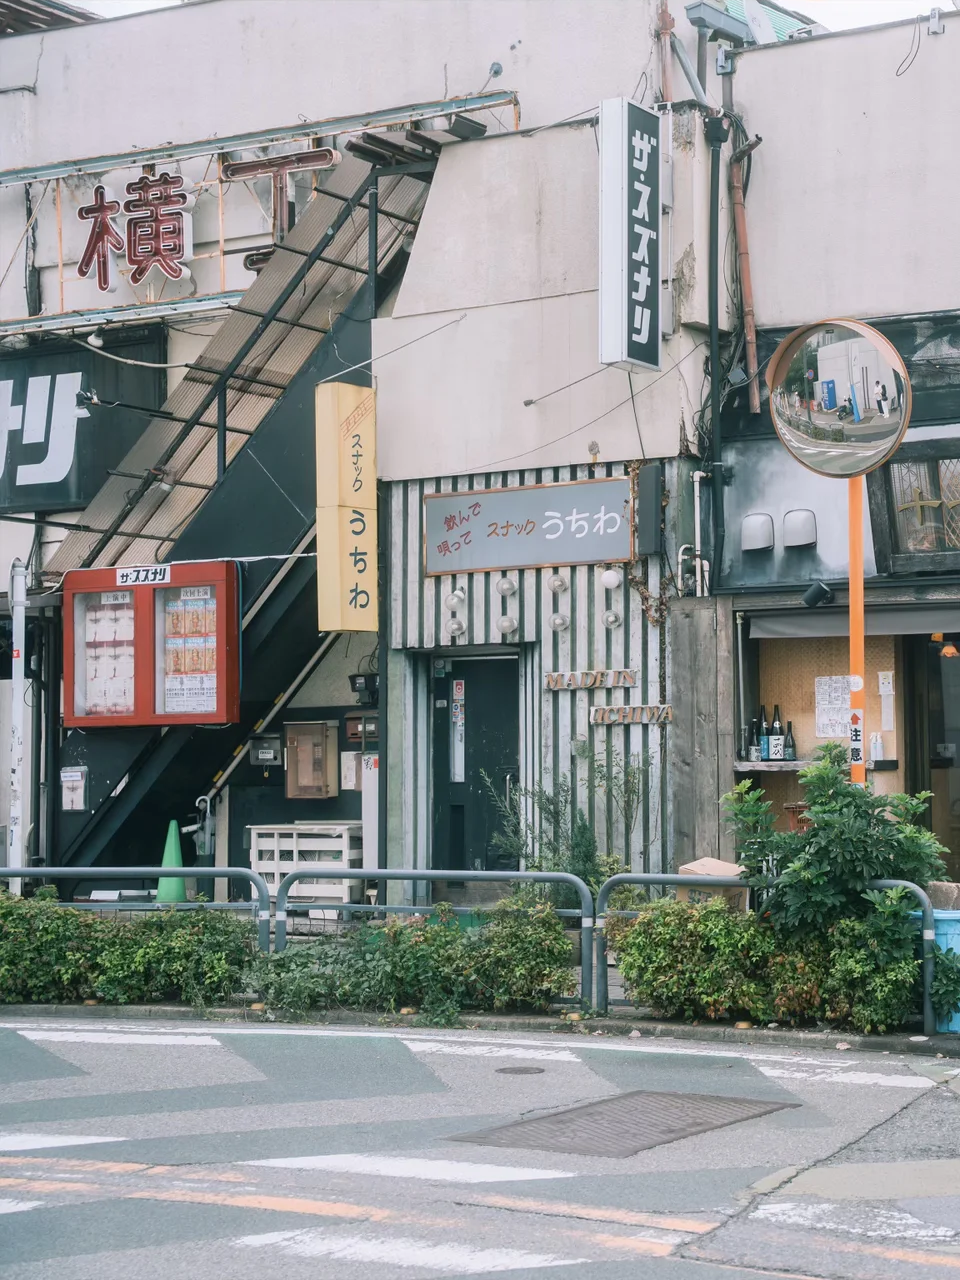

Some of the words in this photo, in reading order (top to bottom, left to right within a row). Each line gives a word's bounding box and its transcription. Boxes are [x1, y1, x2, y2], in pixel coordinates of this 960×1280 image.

[632, 129, 657, 344] ザ・スズナリ
[352, 433, 363, 493] スナック
[443, 502, 482, 532] 飲んで
[487, 518, 536, 537] スナック
[542, 505, 621, 539] うちわ
[349, 509, 370, 609] うちわ
[437, 531, 472, 557] 唄って
[545, 671, 607, 689] MADE
[612, 670, 638, 687] IN
[850, 727, 862, 761] 注意
